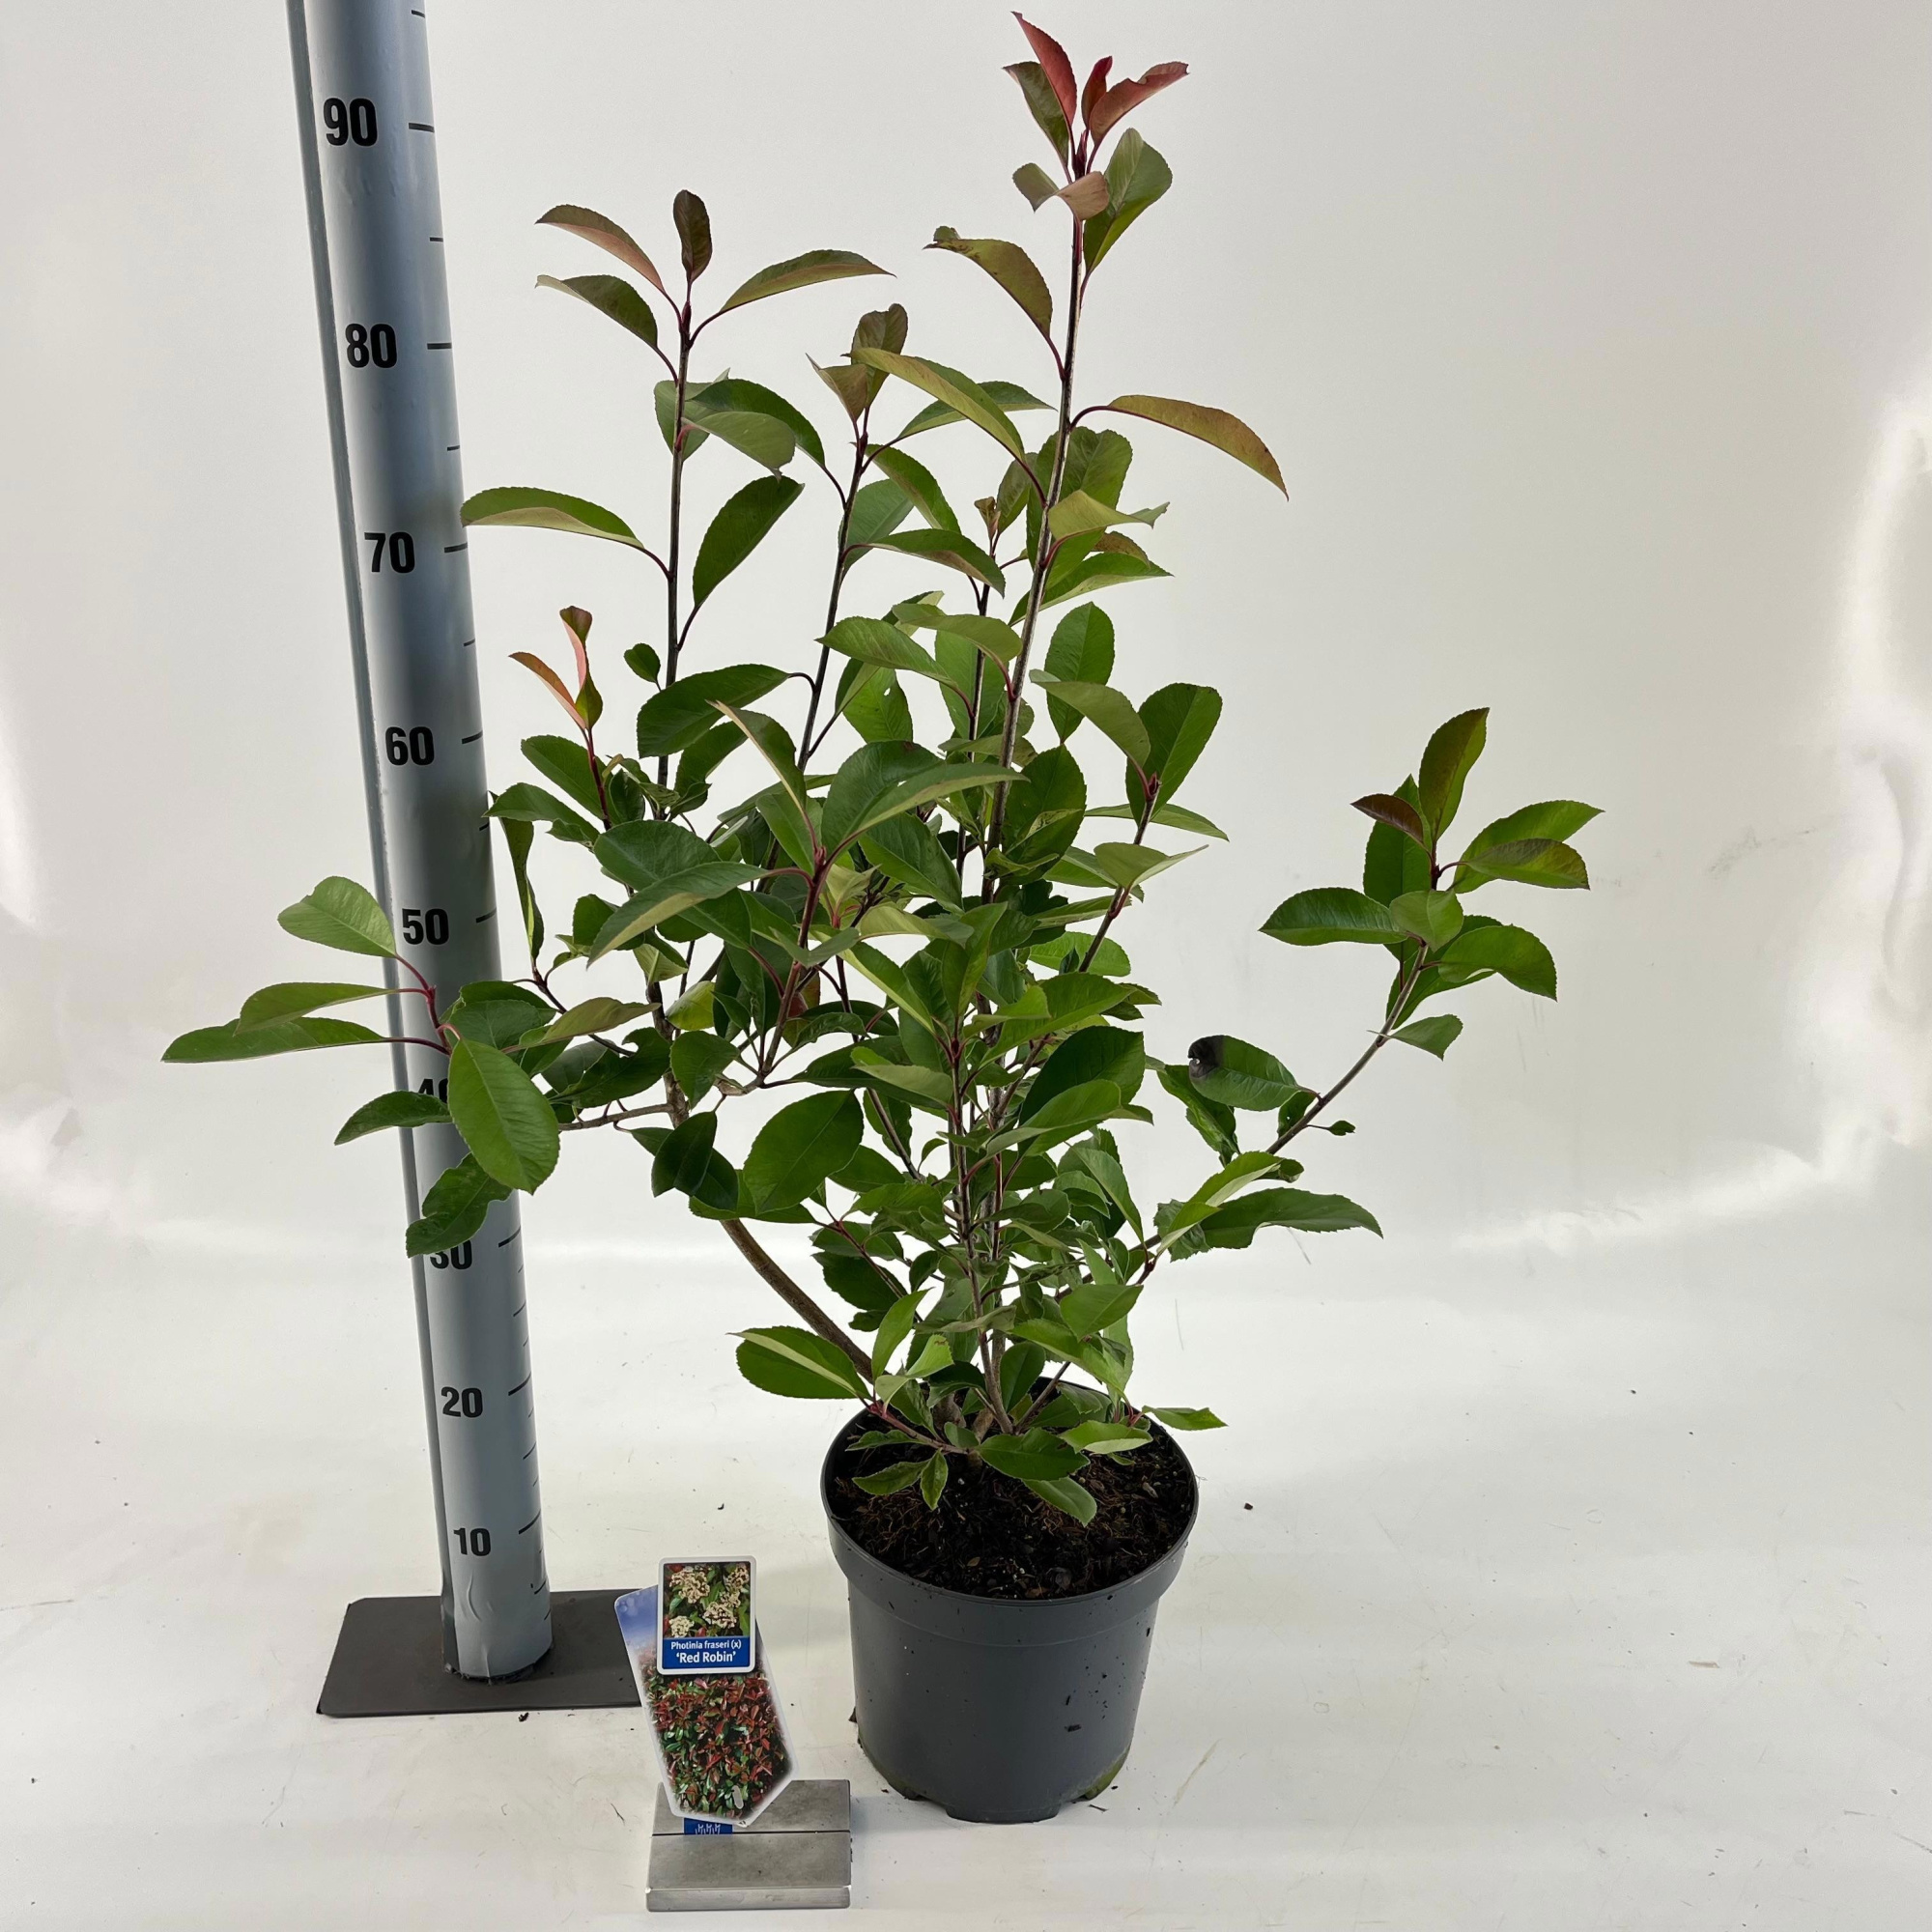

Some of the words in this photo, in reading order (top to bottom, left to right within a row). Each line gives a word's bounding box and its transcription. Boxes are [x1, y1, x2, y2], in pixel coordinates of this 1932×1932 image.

[323, 98, 378, 147] 90
[345, 323, 398, 368] 80
[365, 530, 415, 574] 70
[385, 726, 436, 766] 60
[402, 908, 449, 946] 50
[440, 1386, 484, 1418] 20
[453, 1527, 492, 1557] 10
[670, 1640, 703, 1650] Photinia
[704, 1639, 730, 1650] fraseri
[730, 1638, 742, 1650] (x)
